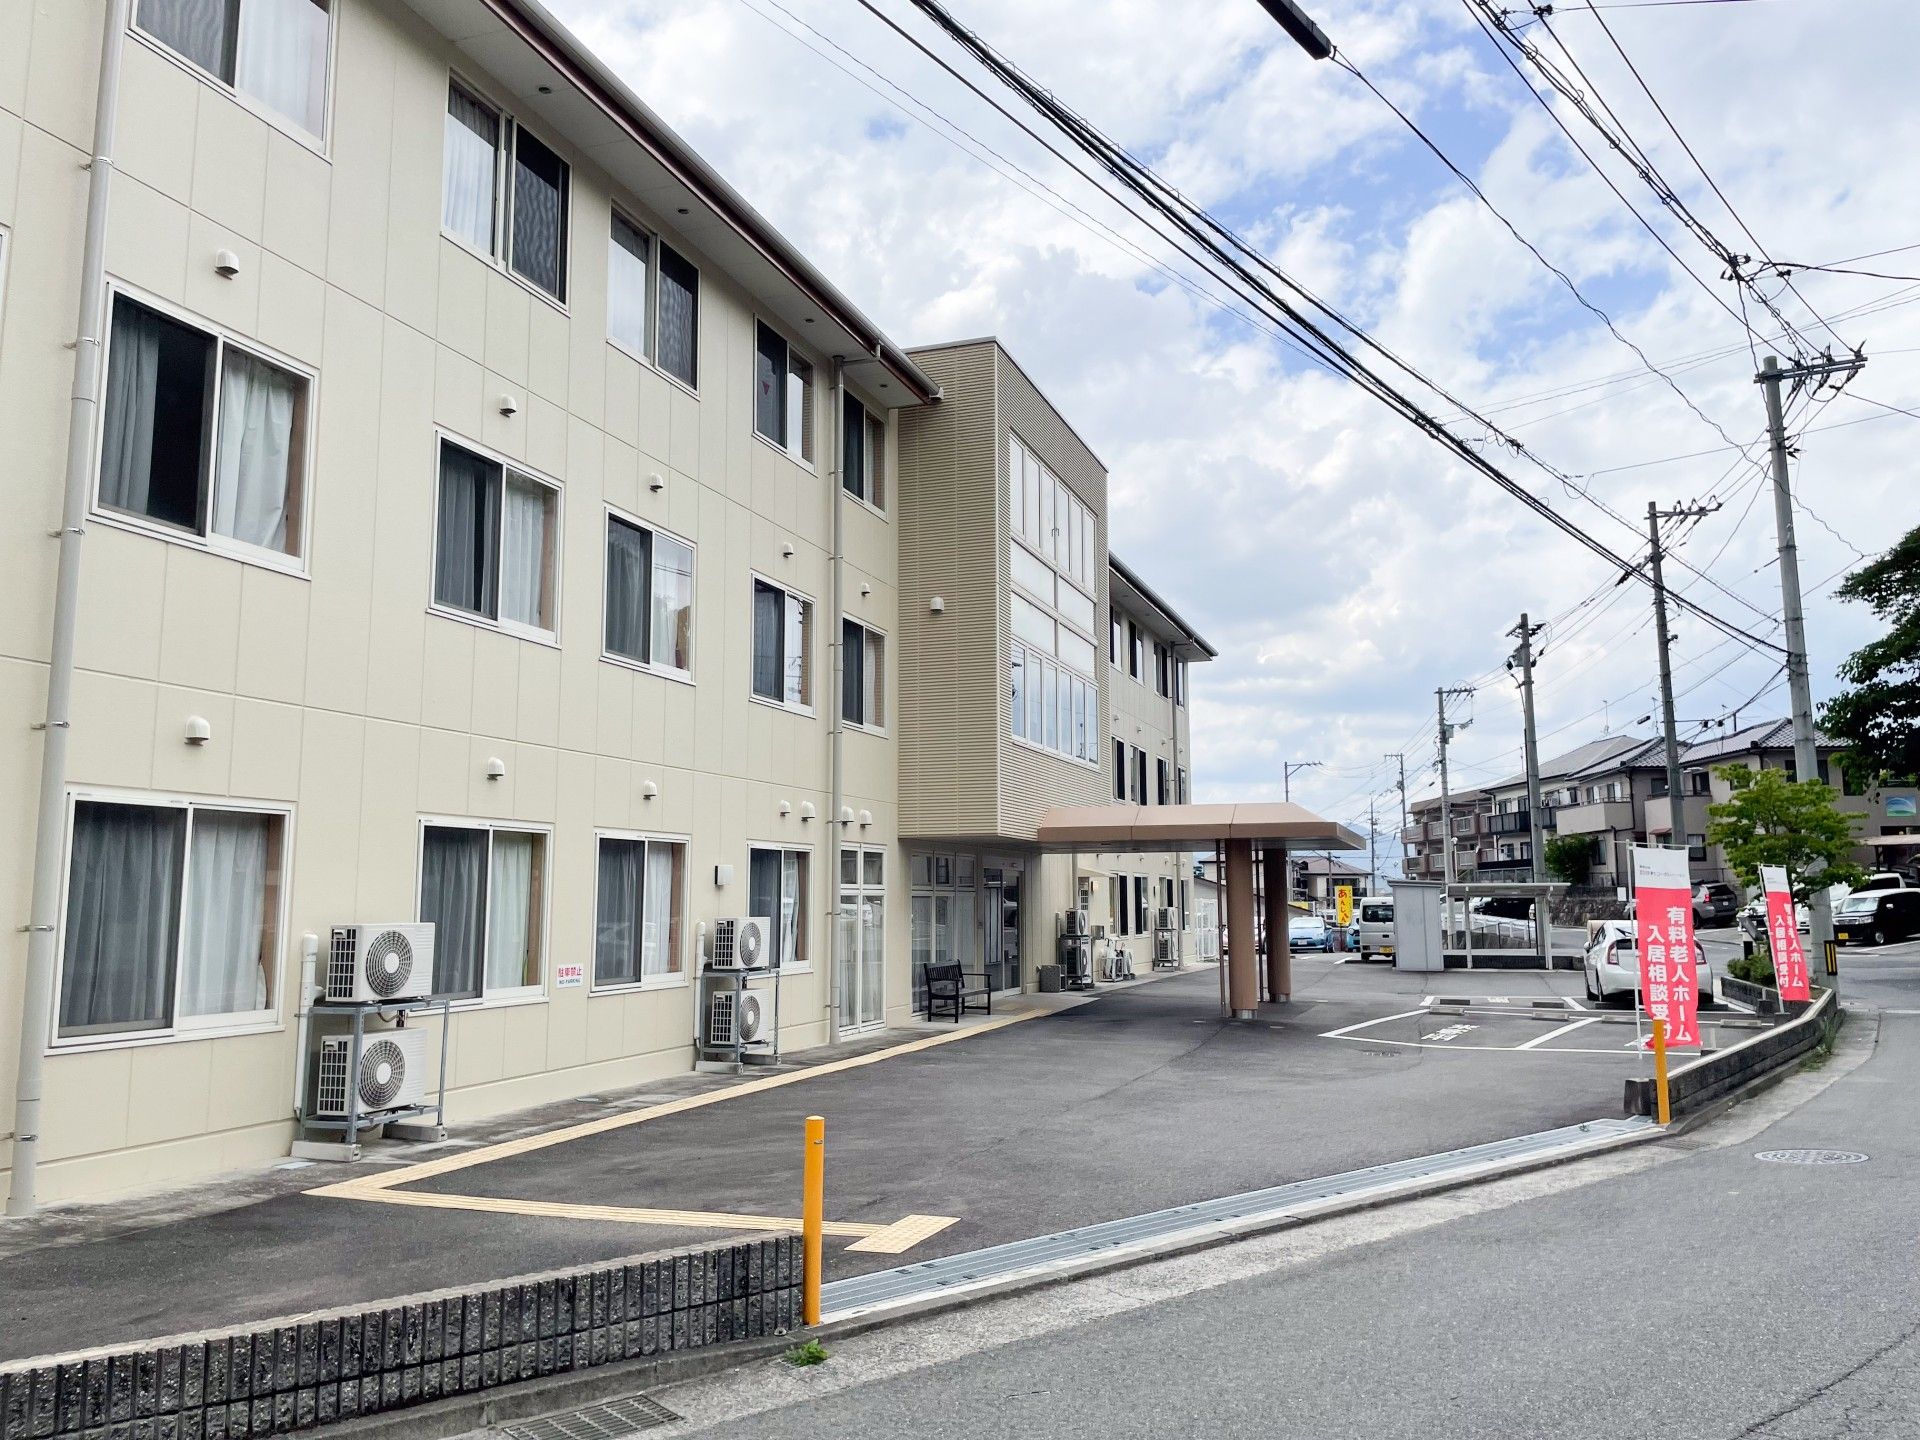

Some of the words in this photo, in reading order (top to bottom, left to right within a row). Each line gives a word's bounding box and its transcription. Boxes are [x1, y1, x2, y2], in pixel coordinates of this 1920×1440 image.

[558, 966, 582, 978] 駐車禁止
[1667, 906, 1692, 1042] 有料老人ホーム
